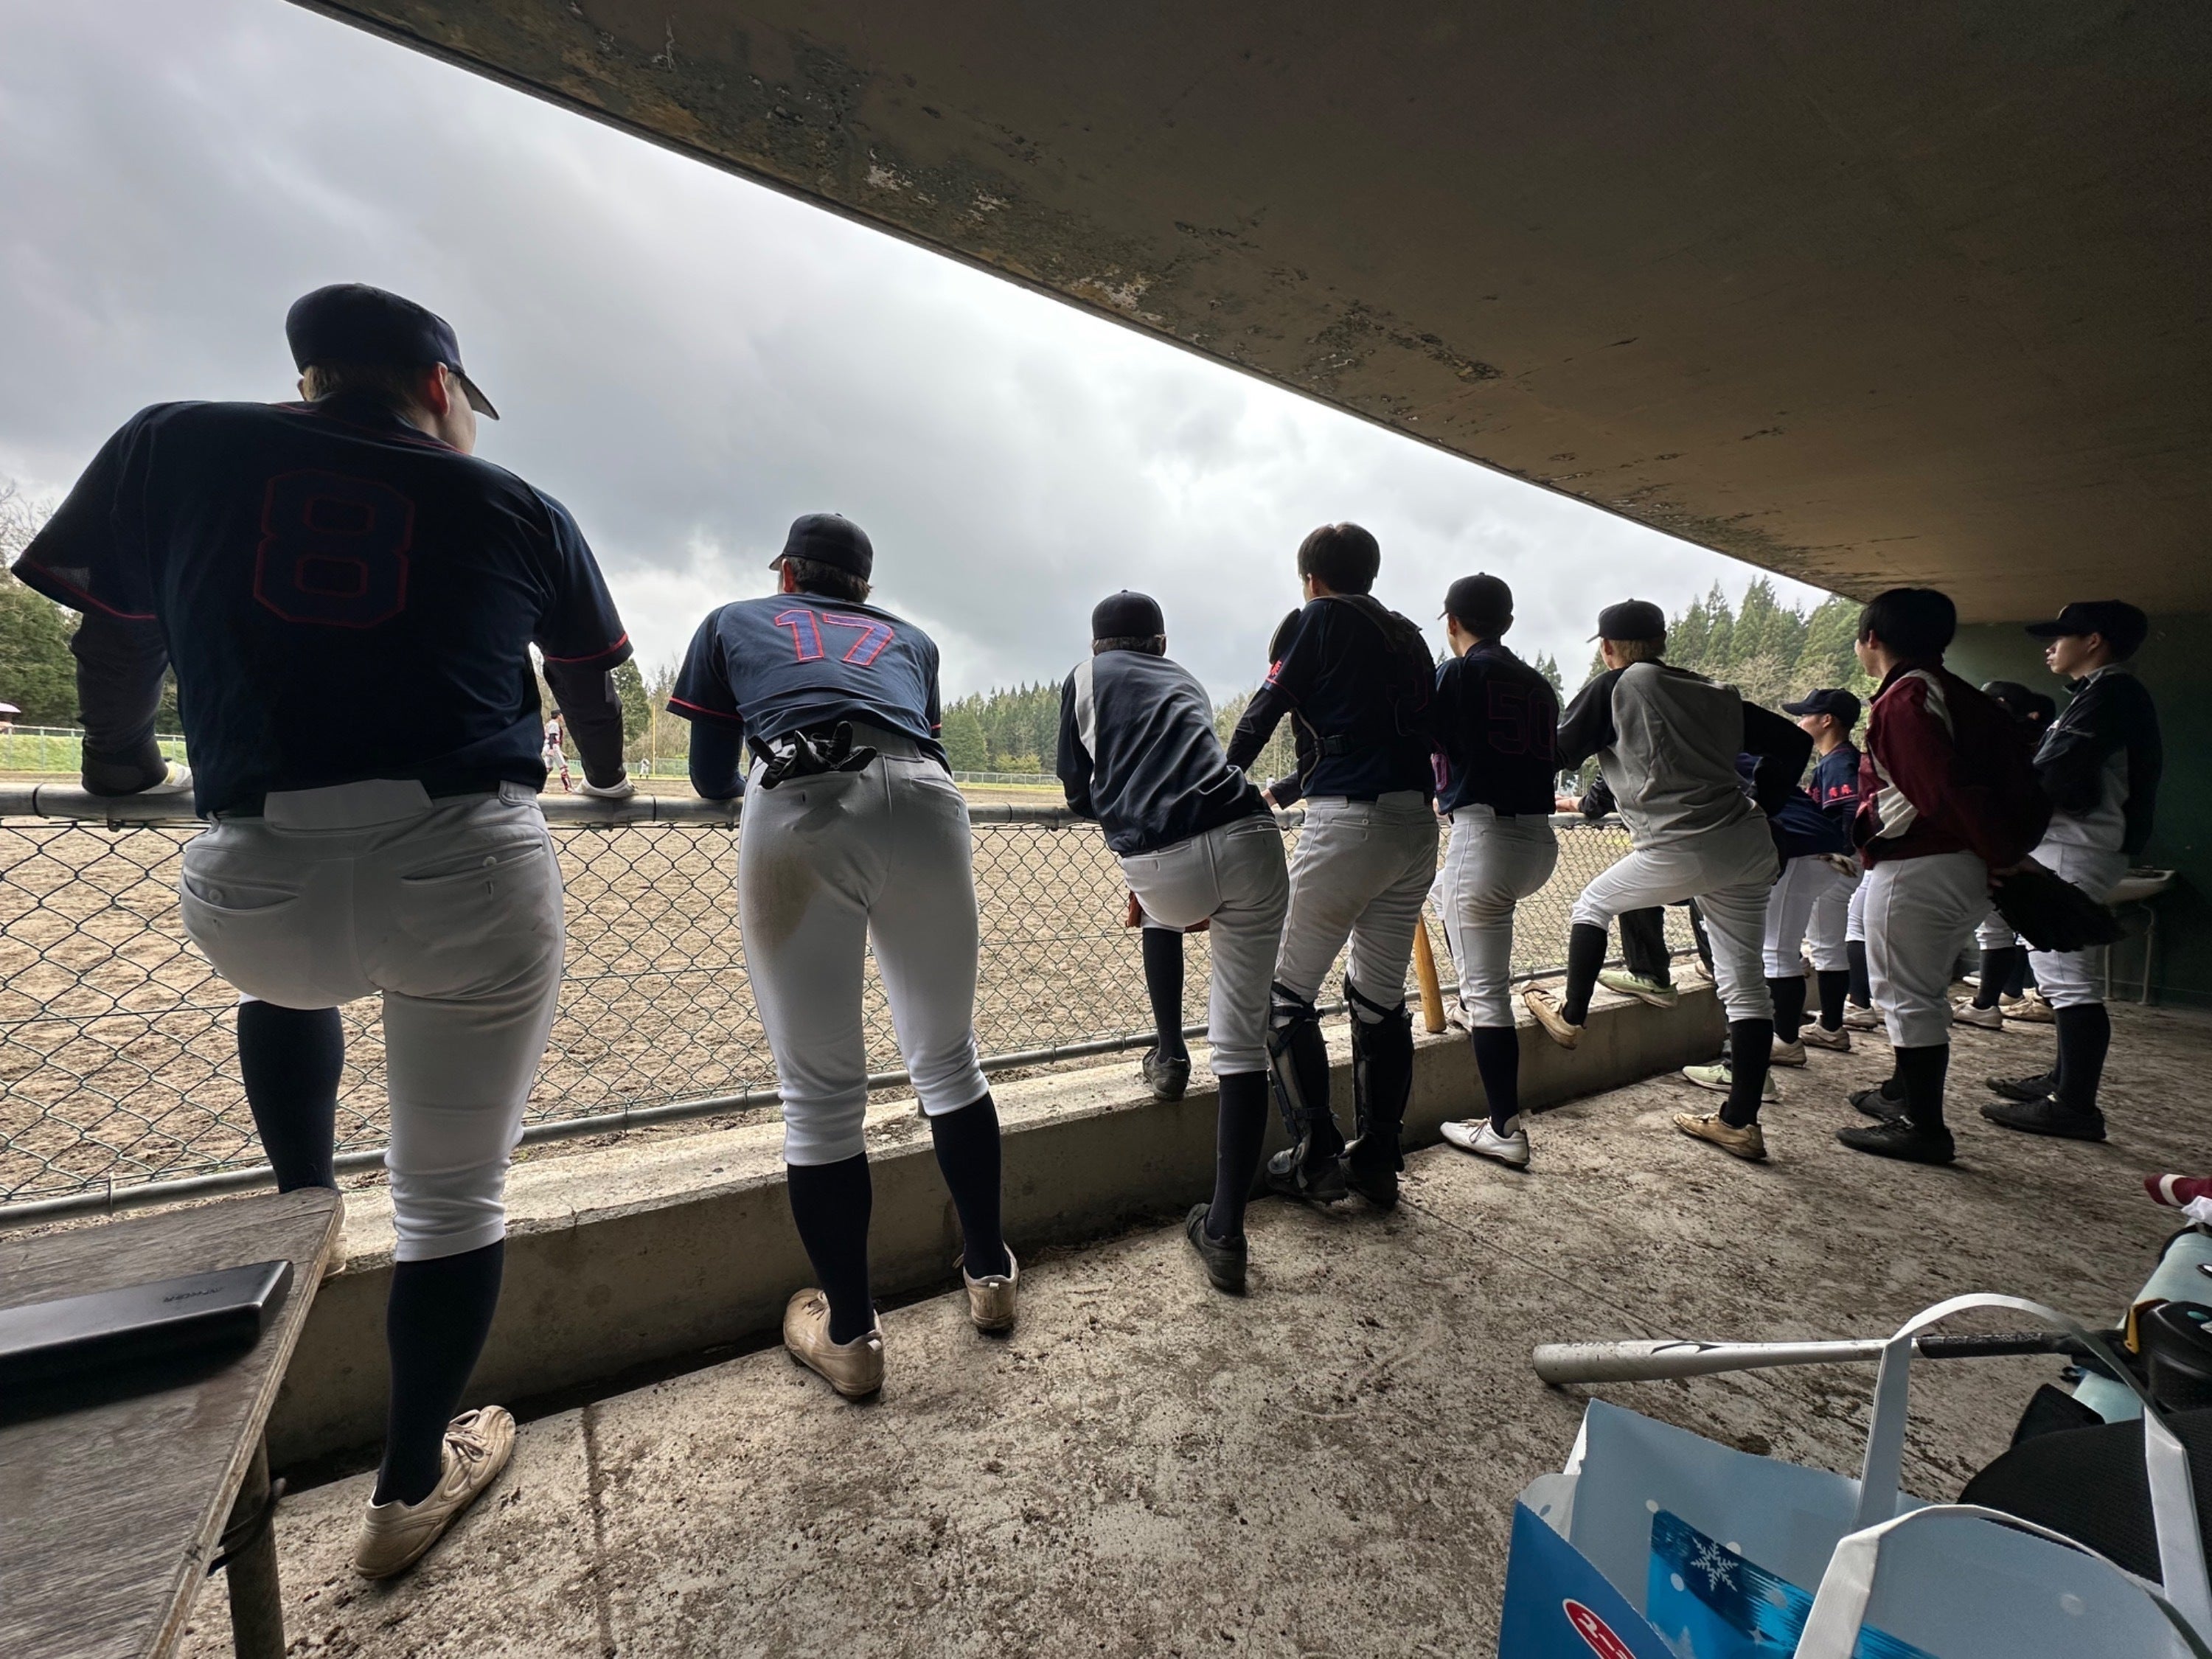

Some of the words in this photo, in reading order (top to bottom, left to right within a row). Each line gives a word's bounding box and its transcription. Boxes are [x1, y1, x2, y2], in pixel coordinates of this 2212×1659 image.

[253, 467, 414, 630] 8
[774, 609, 894, 666] 17
[1486, 680, 1555, 762] 50
